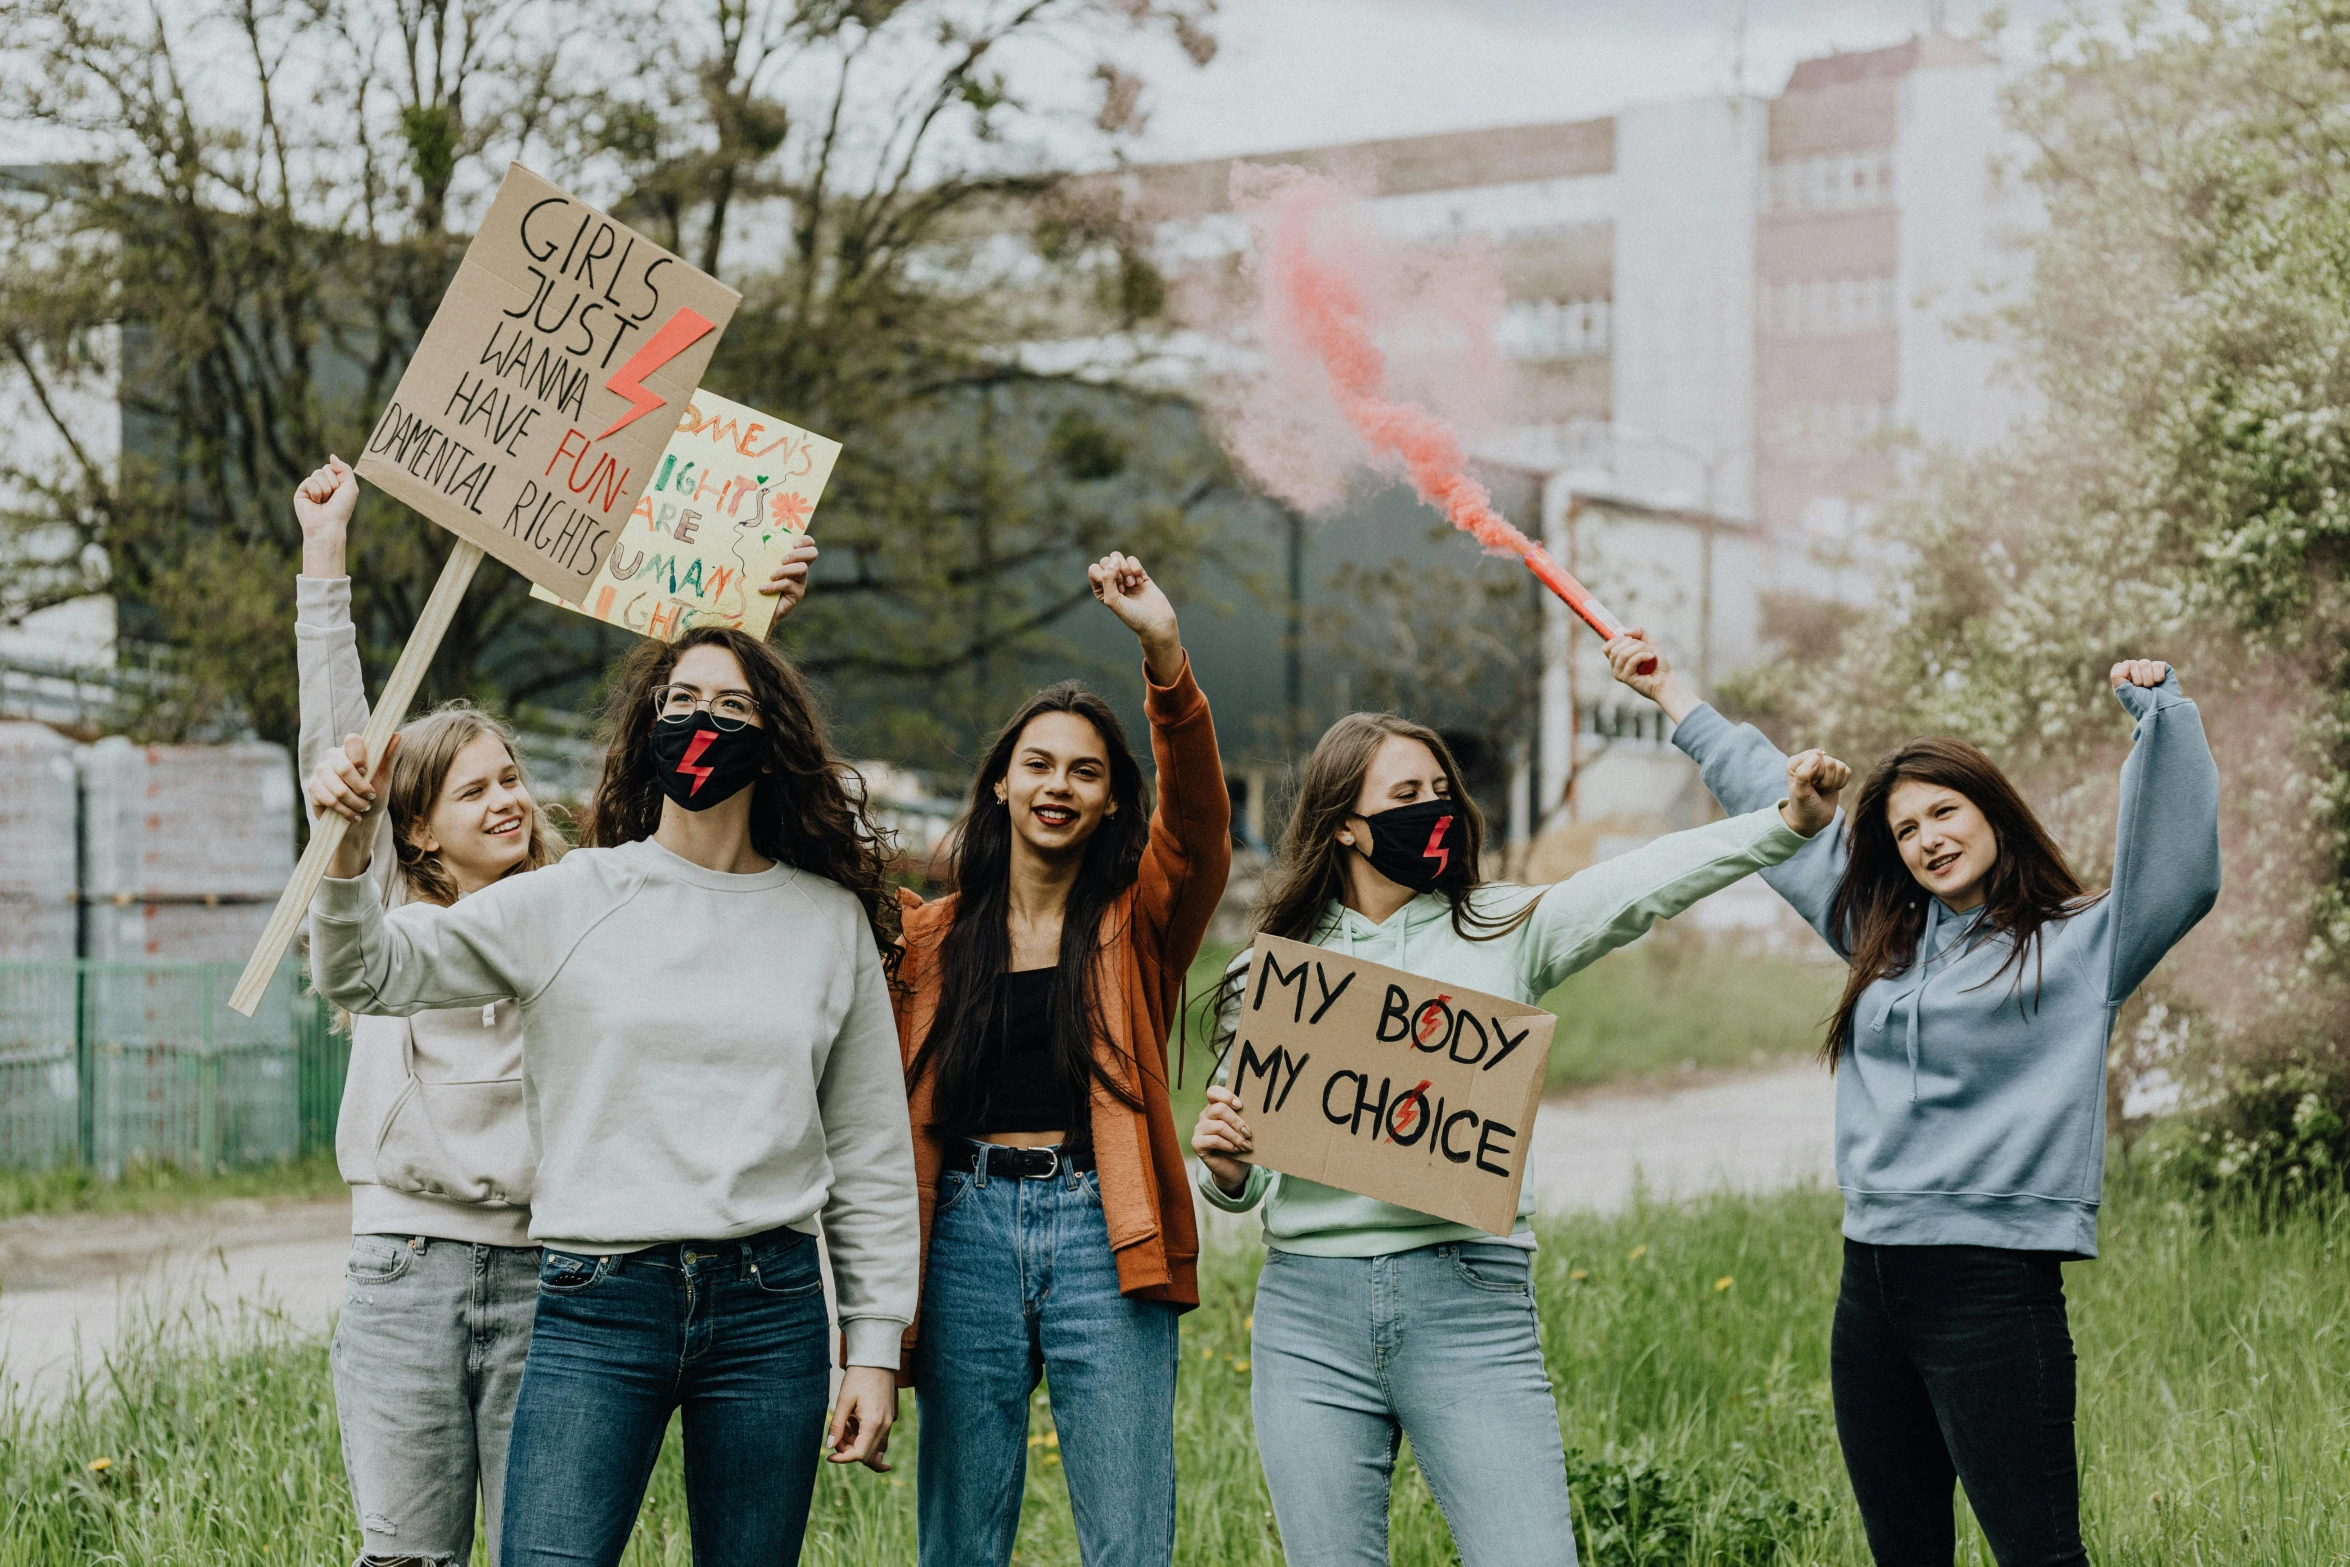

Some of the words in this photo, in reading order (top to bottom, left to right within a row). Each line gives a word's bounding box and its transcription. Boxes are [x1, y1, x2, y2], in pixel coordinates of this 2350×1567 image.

[520, 197, 674, 322] GIRLS
[502, 264, 640, 369] JUST
[480, 320, 590, 422] WANNA
[369, 402, 483, 515] DAMENTAL
[502, 479, 611, 577] RIGHTS
[444, 370, 541, 458] HAVE
[544, 427, 630, 514] FUN-
[654, 453, 770, 528] IGHTS
[675, 402, 813, 477] OMEN'S
[558, 584, 699, 643] IGHT
[609, 541, 747, 619] UMANS
[1252, 950, 1357, 1025] MY
[1375, 983, 1530, 1072] BODY
[1233, 1039, 1311, 1114] MY
[1321, 1069, 1517, 1178] CHOICE
